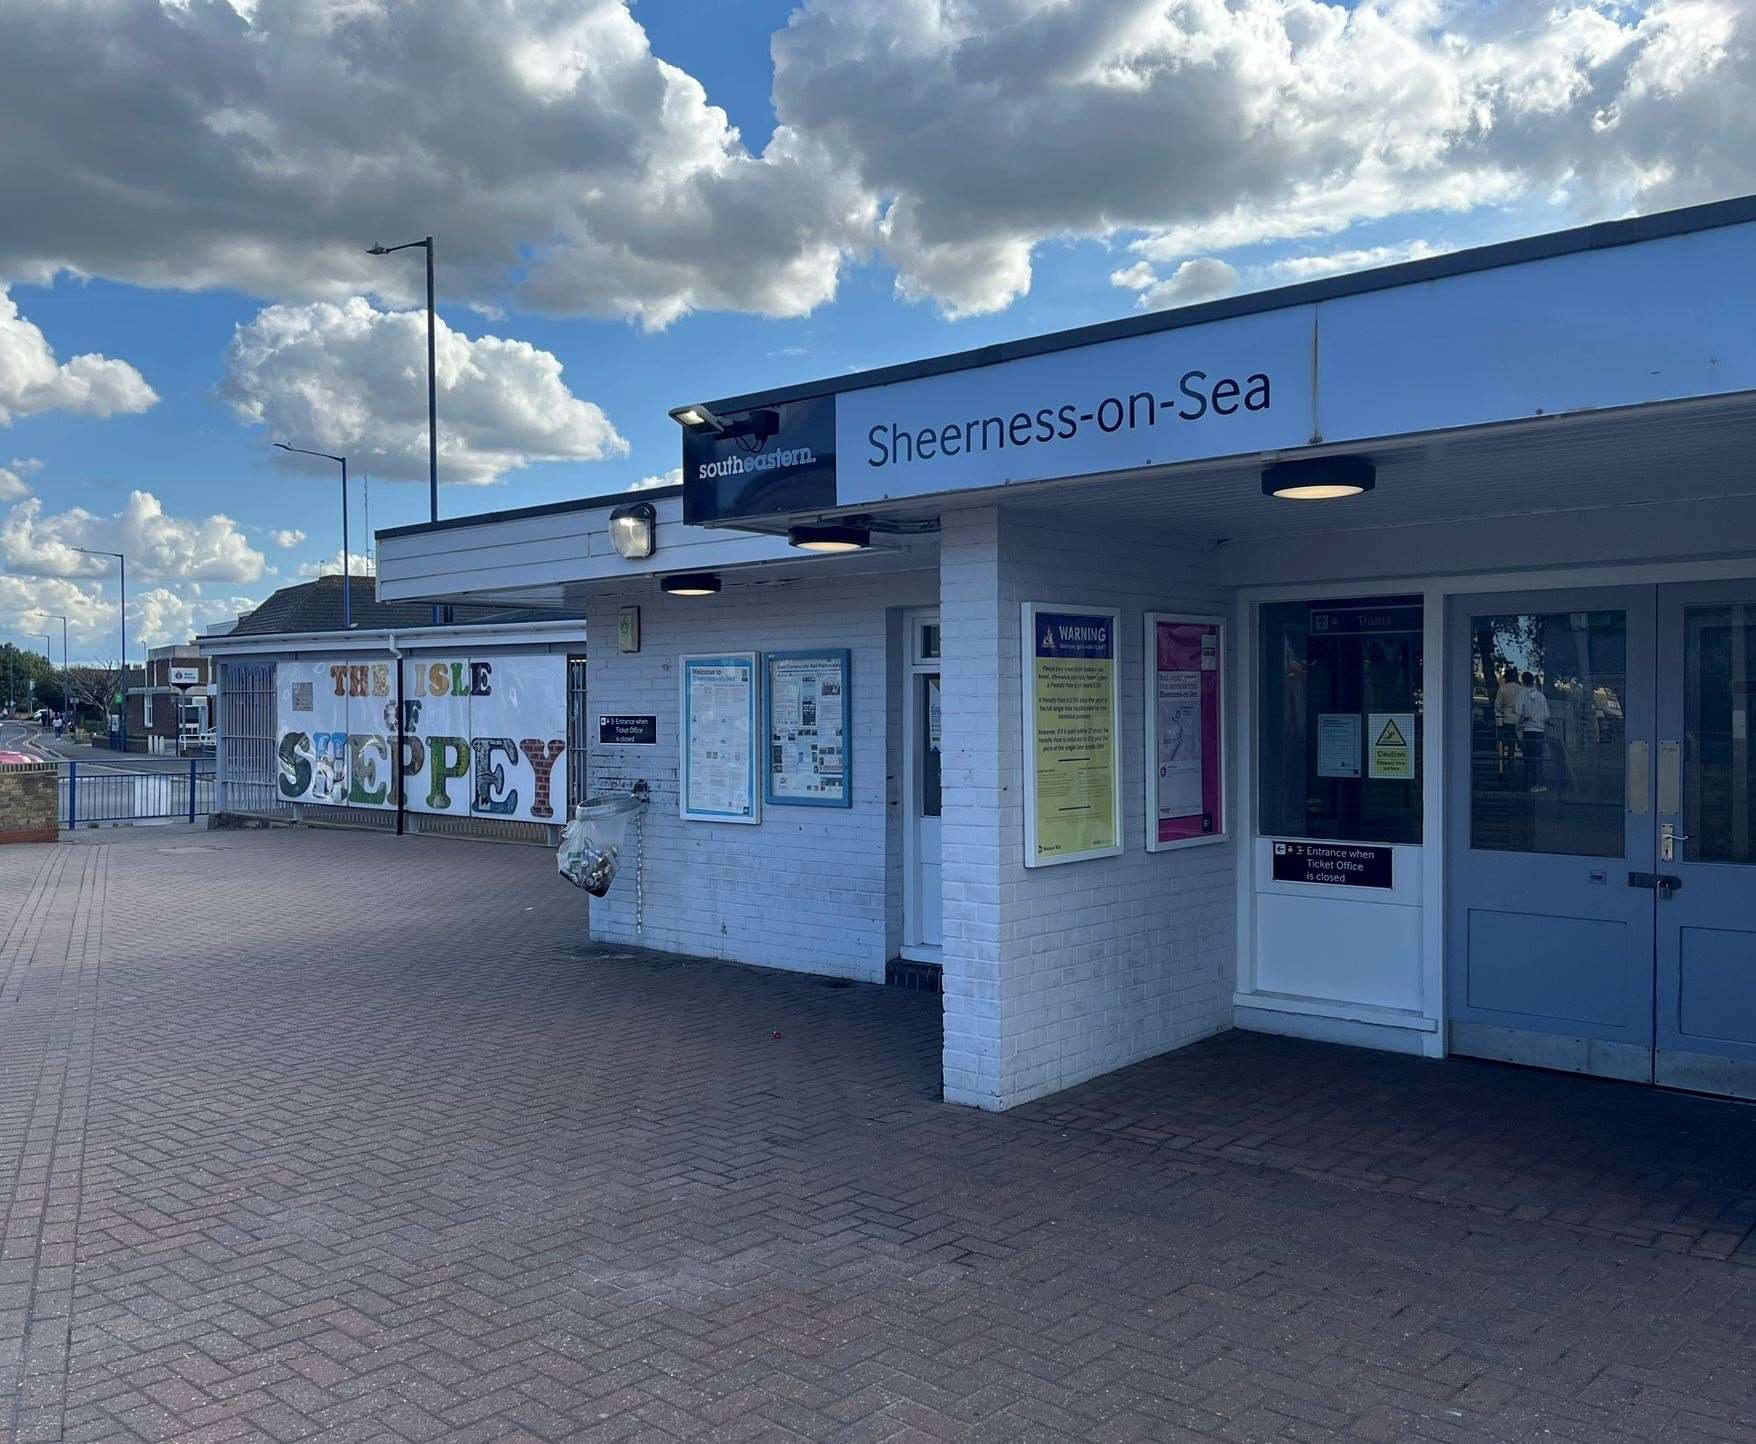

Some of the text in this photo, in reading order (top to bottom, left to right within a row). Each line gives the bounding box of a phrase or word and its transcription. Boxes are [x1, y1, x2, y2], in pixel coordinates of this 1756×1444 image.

[868, 370, 1271, 467] Sheerness-on-Sea
[1358, 615, 1392, 626] Trains
[1059, 625, 1106, 642] WARNING
[692, 668, 715, 676] Welcome
[330, 662, 492, 697] THE ISLE
[384, 699, 423, 733] OF
[1377, 750, 1406, 758] Caution
[279, 731, 566, 818] SHEPPEY
[1307, 846, 1374, 859] Entrance when
[1307, 859, 1364, 872] Ticket Office
[1306, 872, 1346, 882] is closed
